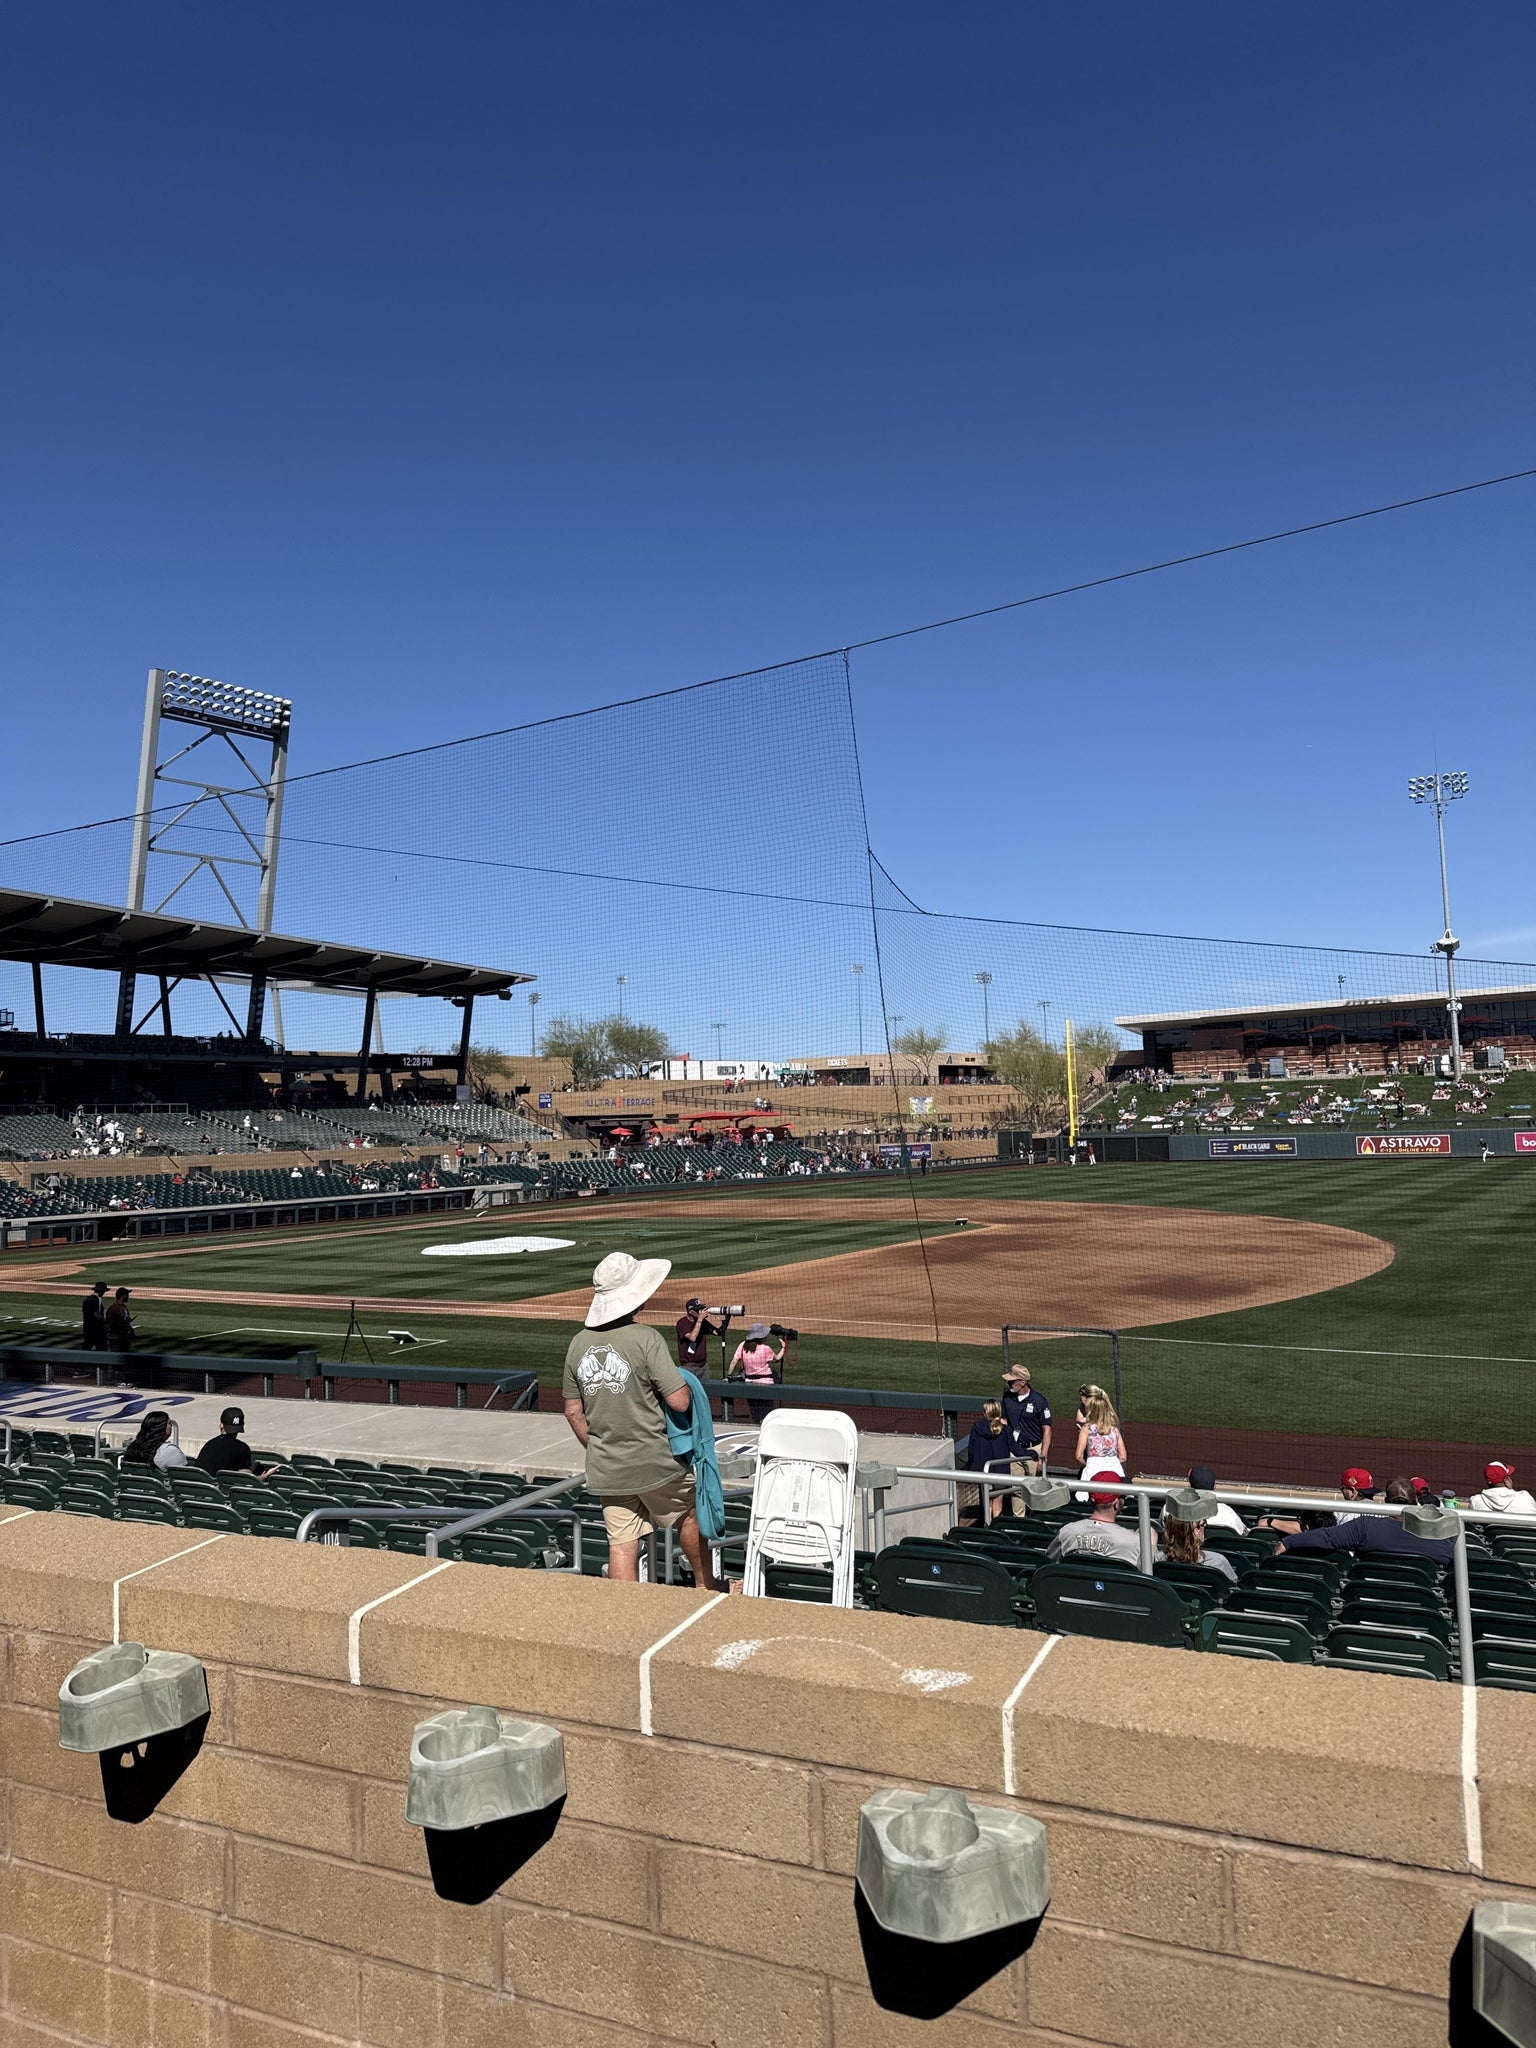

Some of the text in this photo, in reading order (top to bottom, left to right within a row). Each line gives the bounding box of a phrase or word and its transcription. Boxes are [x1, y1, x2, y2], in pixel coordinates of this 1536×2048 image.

[403, 1057, 433, 1067] 12:28 PM
[585, 1098, 655, 1107] ULTRA TERRACE
[1379, 1137, 1441, 1148] ASTRAVO
